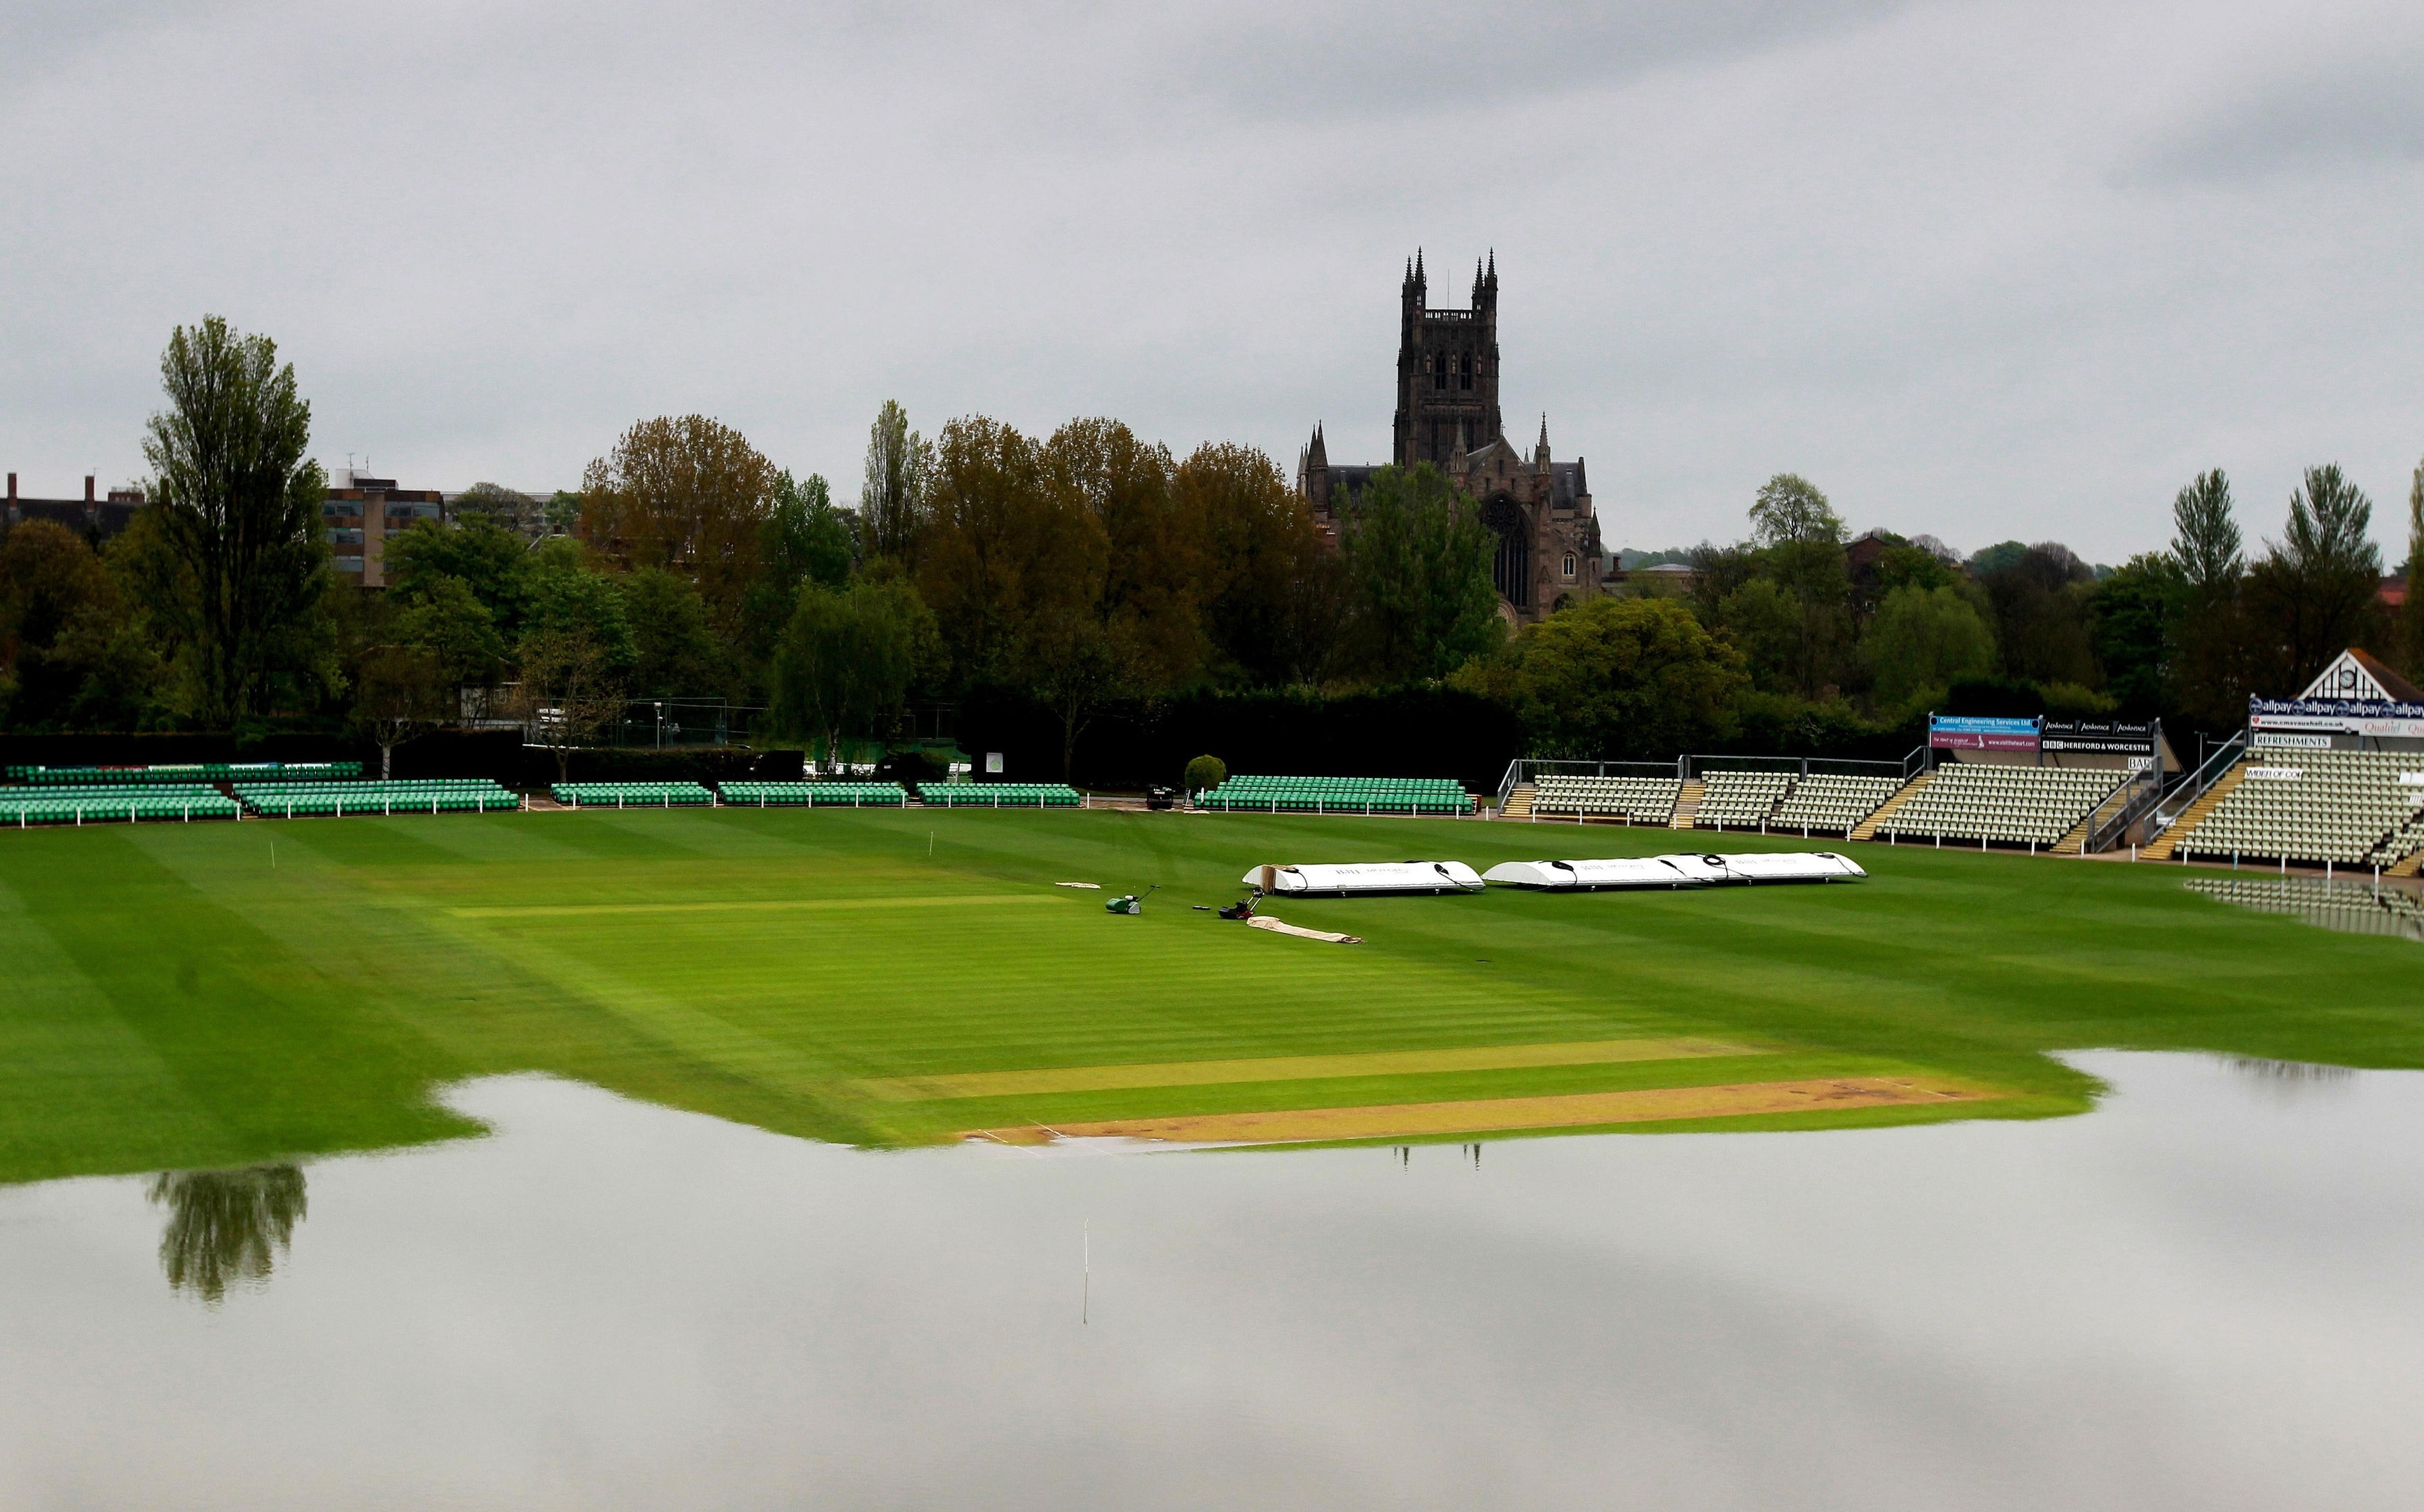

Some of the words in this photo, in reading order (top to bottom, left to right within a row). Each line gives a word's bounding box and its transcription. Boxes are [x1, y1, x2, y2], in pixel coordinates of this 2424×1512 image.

[2263, 700, 2292, 714] allpay
[2305, 700, 2336, 715] allpay
[2350, 701, 2381, 716] allpay
[1961, 718, 1995, 727] Engineering
[2042, 741, 2063, 749] BBC
[2107, 743, 2150, 752] WORCESTER
[2257, 736, 2327, 747] REFRESHMENTS
